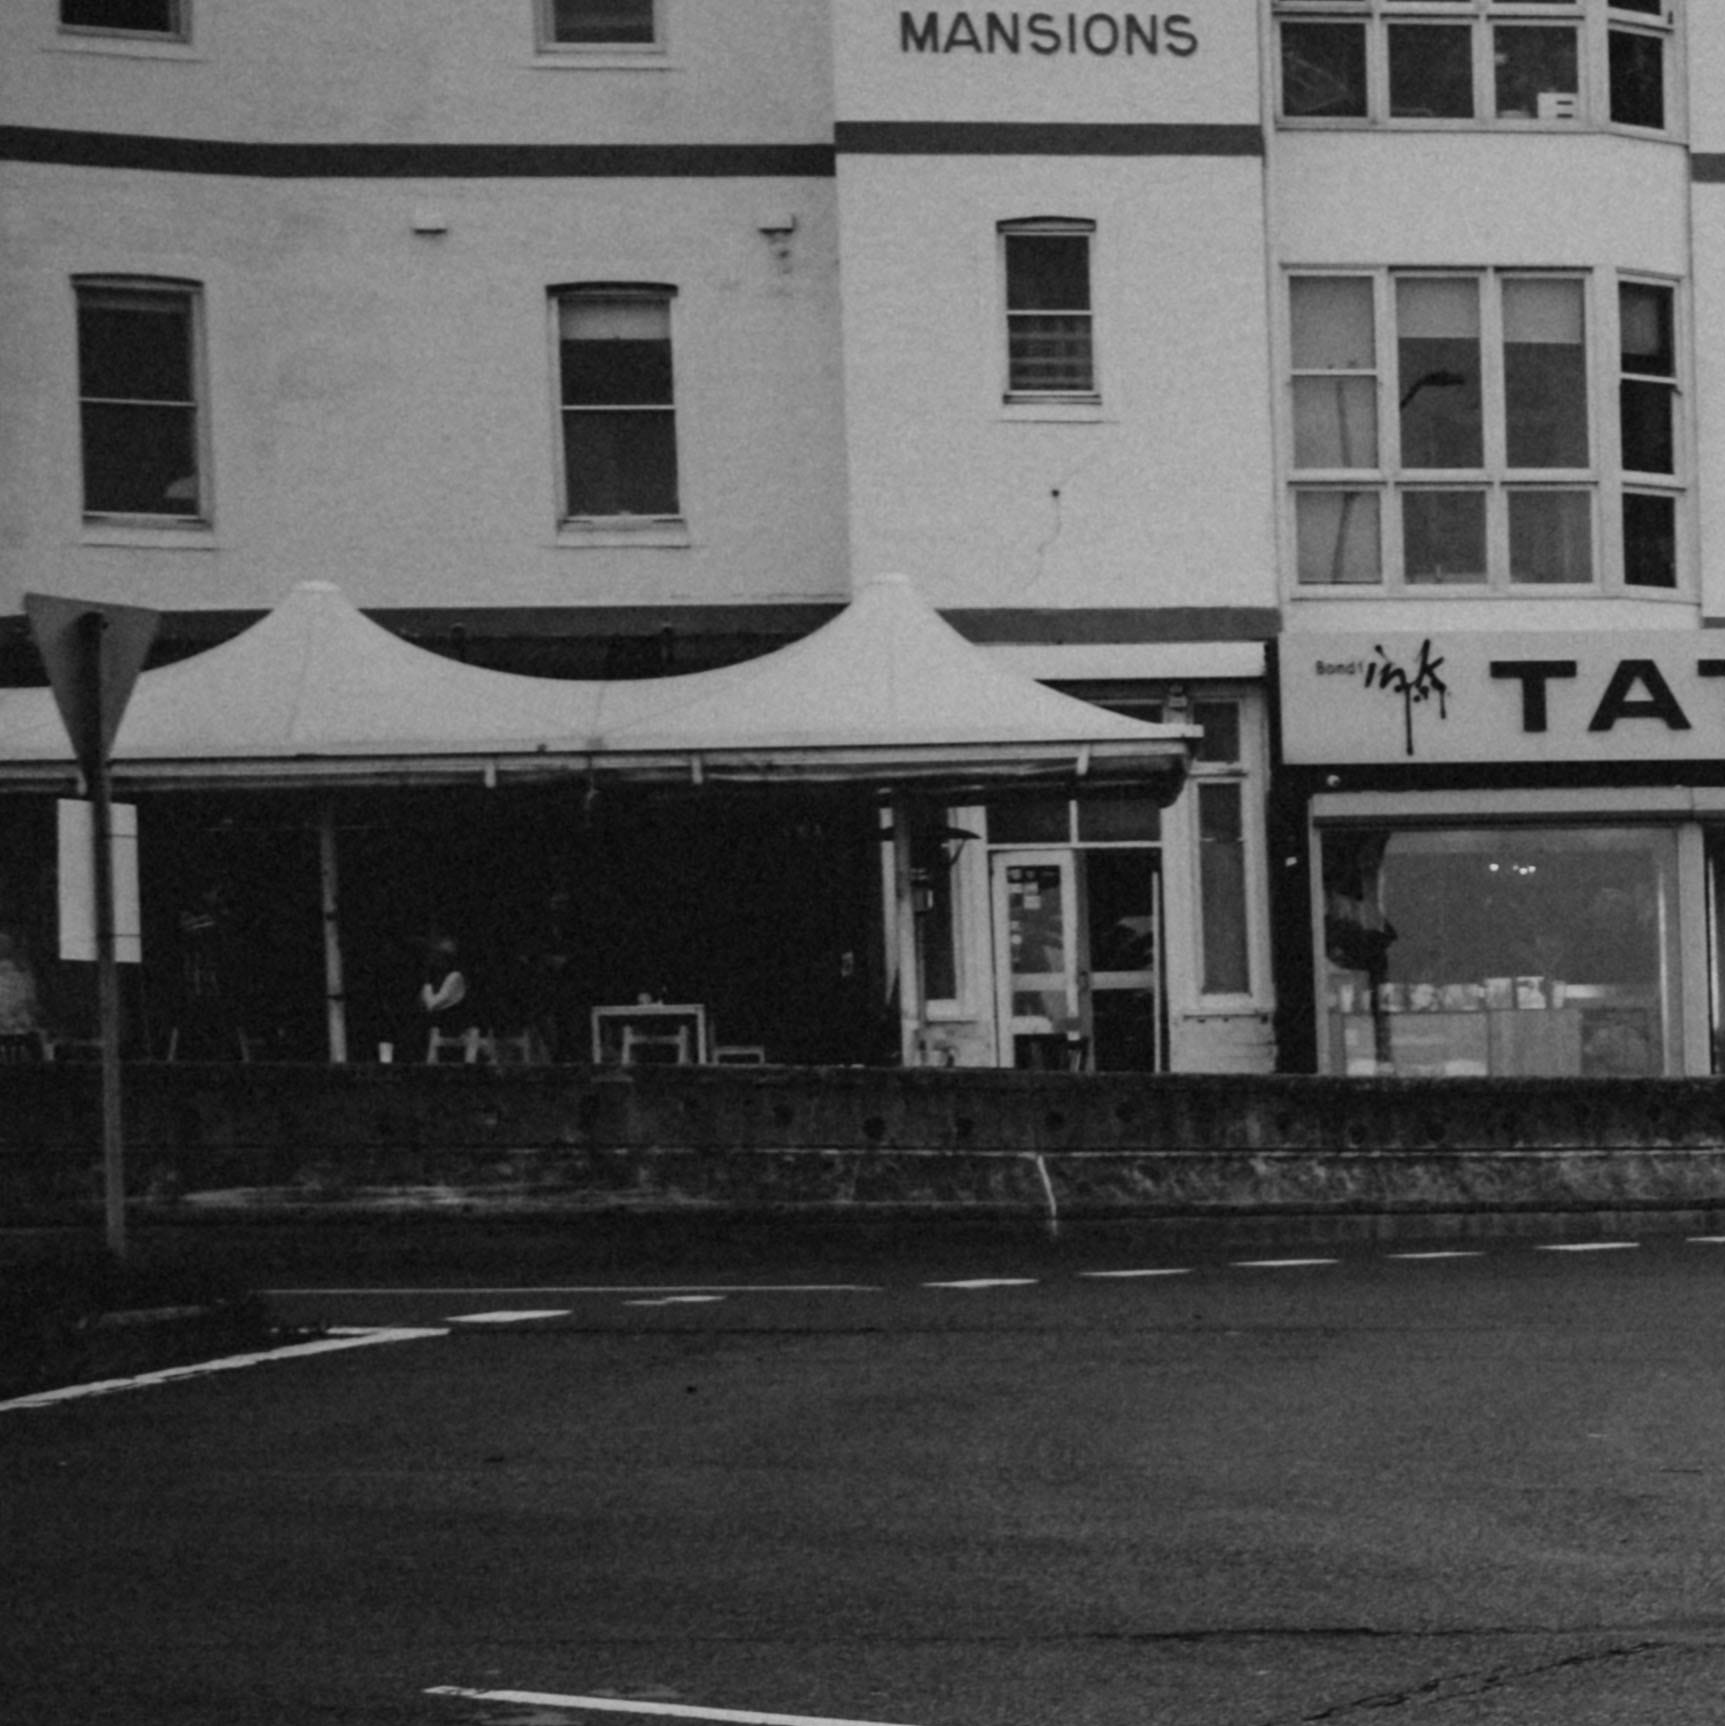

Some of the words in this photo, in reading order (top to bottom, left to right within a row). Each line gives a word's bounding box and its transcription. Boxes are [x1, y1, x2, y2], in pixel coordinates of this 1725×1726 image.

[901, 12, 1200, 57] MANSIONS
[1315, 660, 1364, 675] Bondi
[1364, 638, 1448, 756] ink
